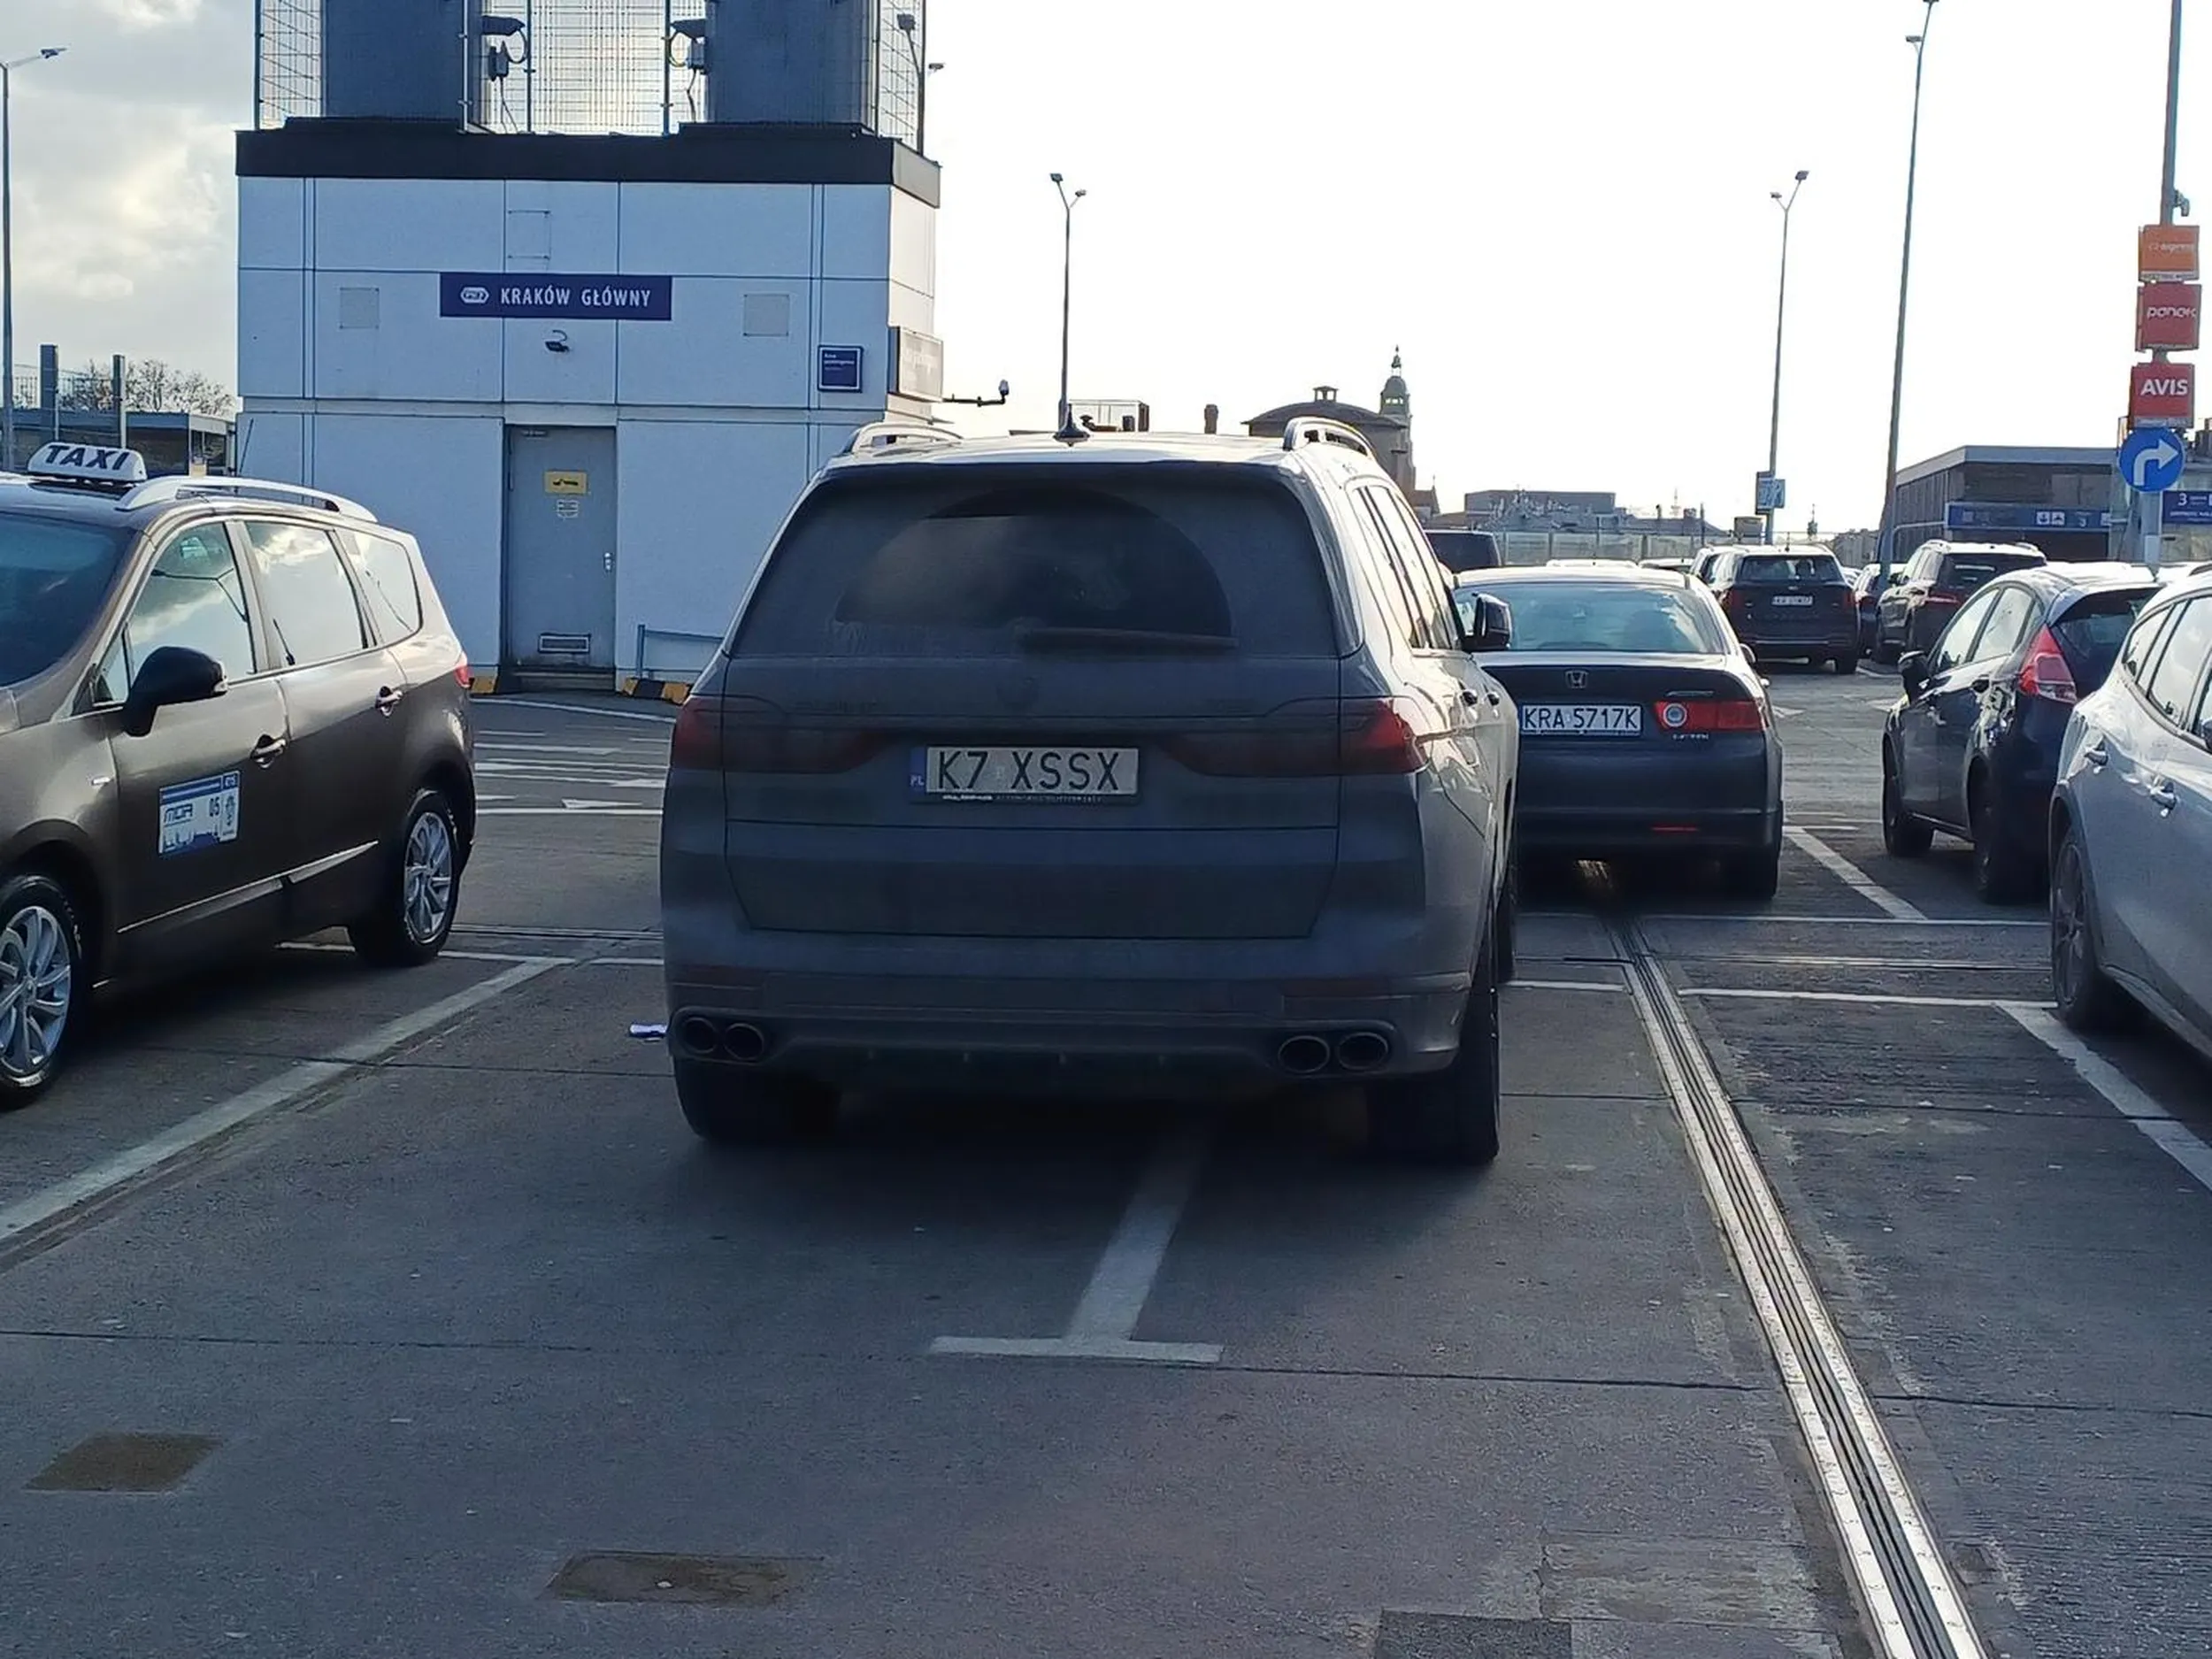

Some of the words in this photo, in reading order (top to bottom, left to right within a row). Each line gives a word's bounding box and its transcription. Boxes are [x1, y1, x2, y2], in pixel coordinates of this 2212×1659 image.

[501, 284, 571, 304] KRAKÓW
[581, 286, 651, 307] GŁÓWNY
[2140, 379, 2188, 396] AVIS
[45, 445, 129, 471] TAXI
[2177, 492, 2187, 506] 3
[1525, 708, 1564, 728] KRA
[1573, 708, 1639, 728] 5717K
[910, 775, 925, 786] PL
[939, 751, 988, 789] K7
[1011, 751, 1118, 790] XSSX
